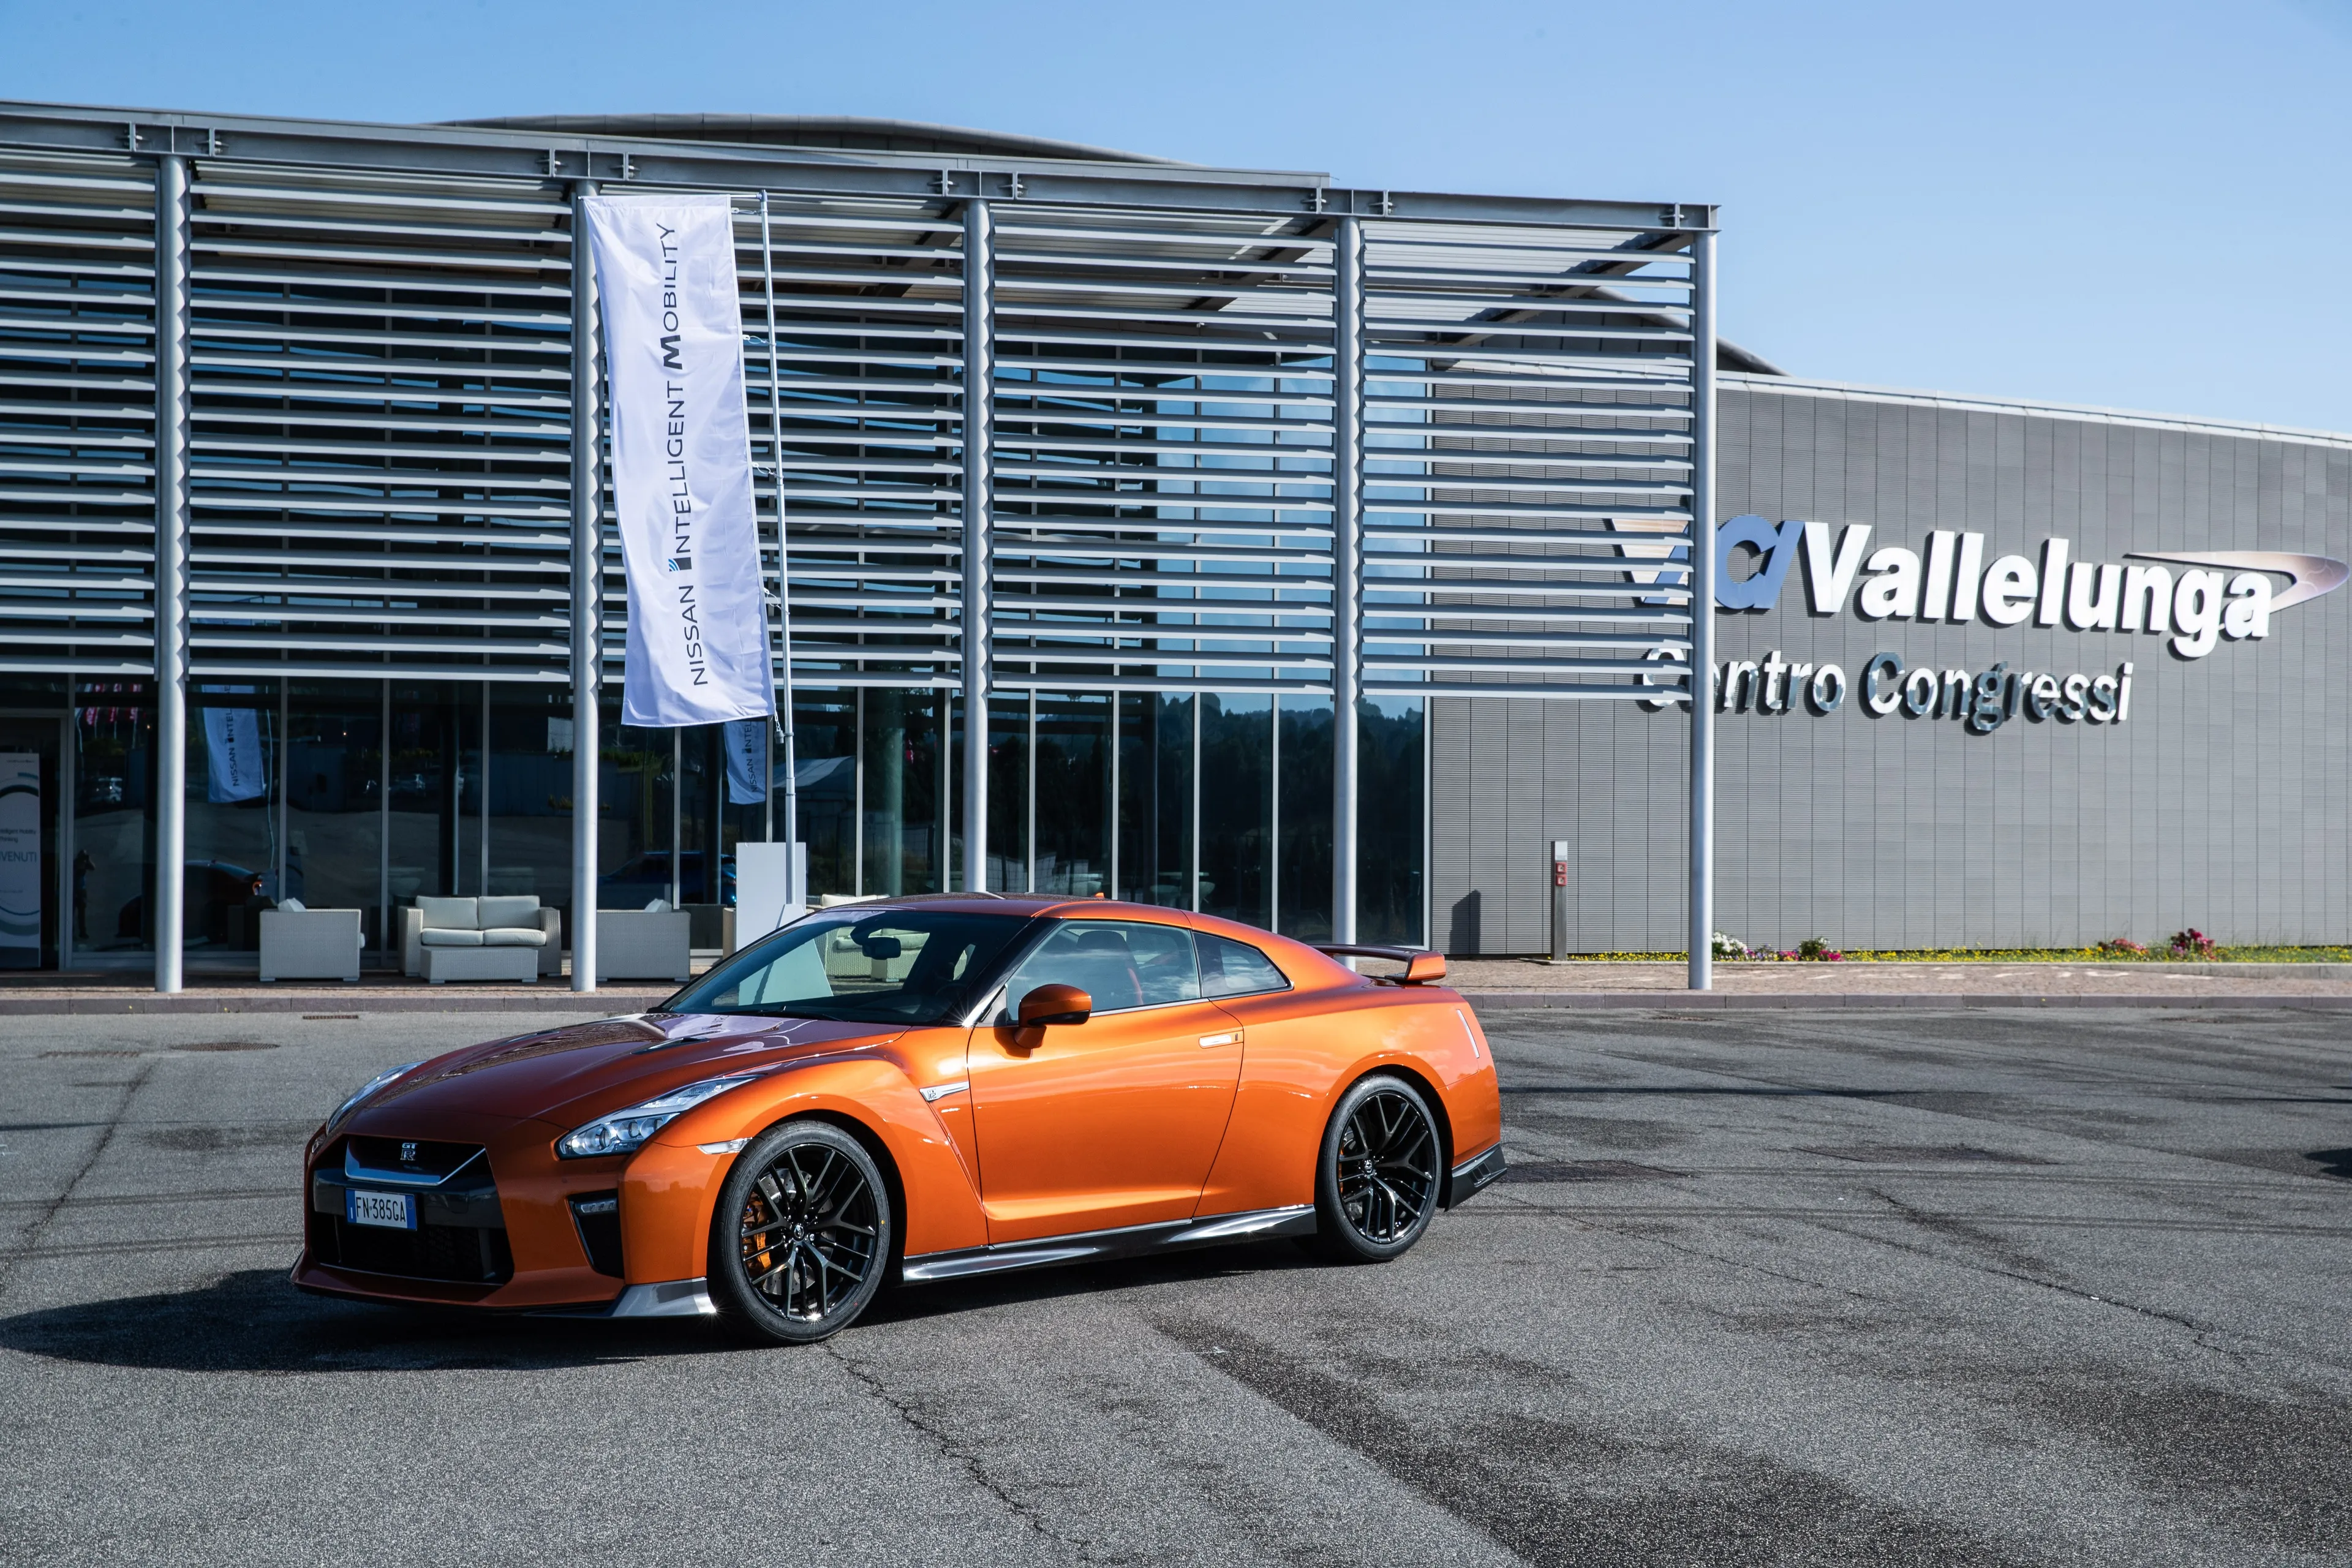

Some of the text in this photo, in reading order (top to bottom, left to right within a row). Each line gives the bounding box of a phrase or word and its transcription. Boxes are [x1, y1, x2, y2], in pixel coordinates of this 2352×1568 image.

[657, 223, 708, 686] NISSAN INTELLIGENT MOBILITY
[1804, 521, 2273, 658] Vallelunga
[1642, 647, 2133, 731] Cntro Congressi
[228, 747, 239, 786] NISSAN
[746, 758, 758, 793] NISSAN
[0, 851, 36, 862] VENUTI
